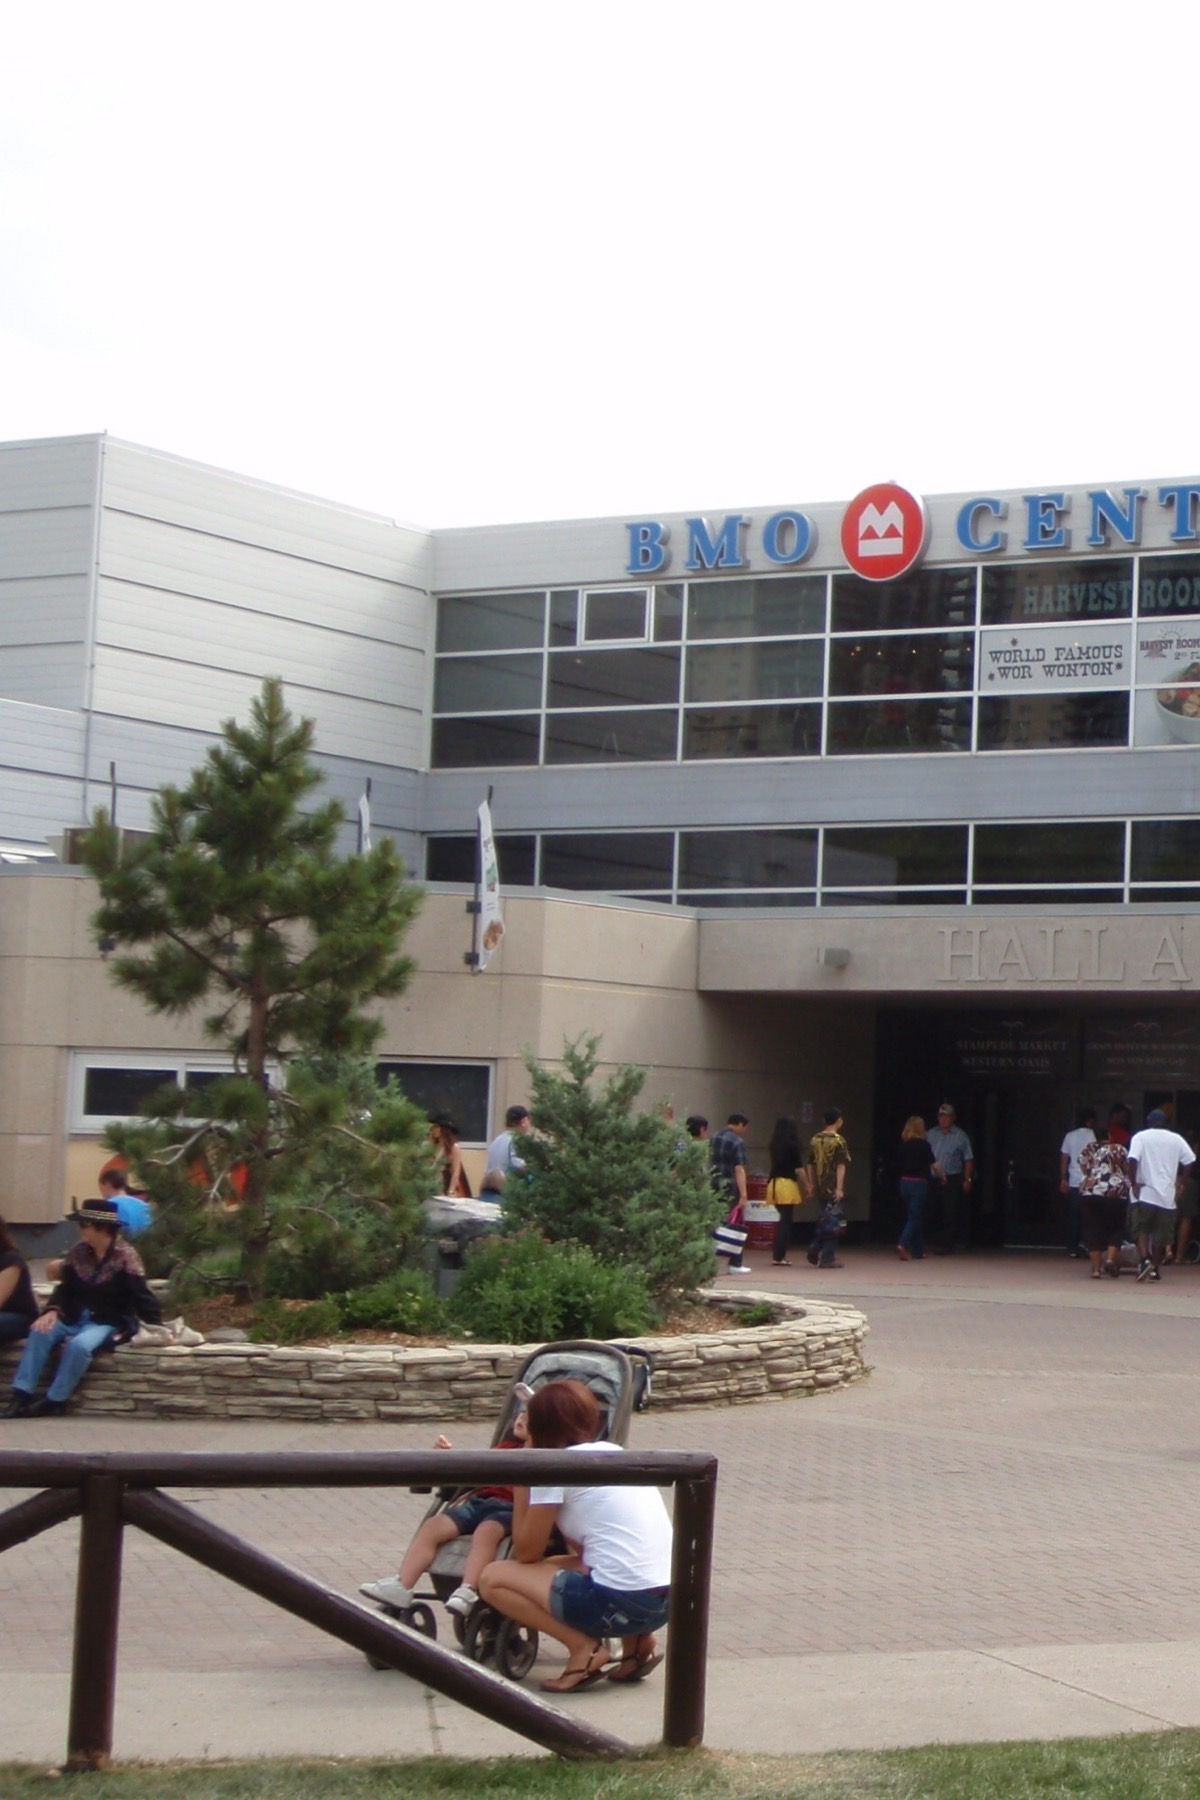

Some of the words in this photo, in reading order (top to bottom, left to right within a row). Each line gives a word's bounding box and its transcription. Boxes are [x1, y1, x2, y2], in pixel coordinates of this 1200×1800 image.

[626, 510, 814, 574] BMO
[1023, 581, 1133, 614] HARVEST
[1140, 639, 1174, 651] HARVEST
[1176, 637, 1200, 649] ROOM
[989, 648, 1046, 664] WORLD
[1054, 645, 1123, 661] FAMOUS
[997, 665, 1033, 680] WOR
[1042, 662, 1114, 677] WONTON
[936, 926, 1127, 983] HALL
[1142, 925, 1193, 983] A
[1017, 1057, 1051, 1068] OASIS
